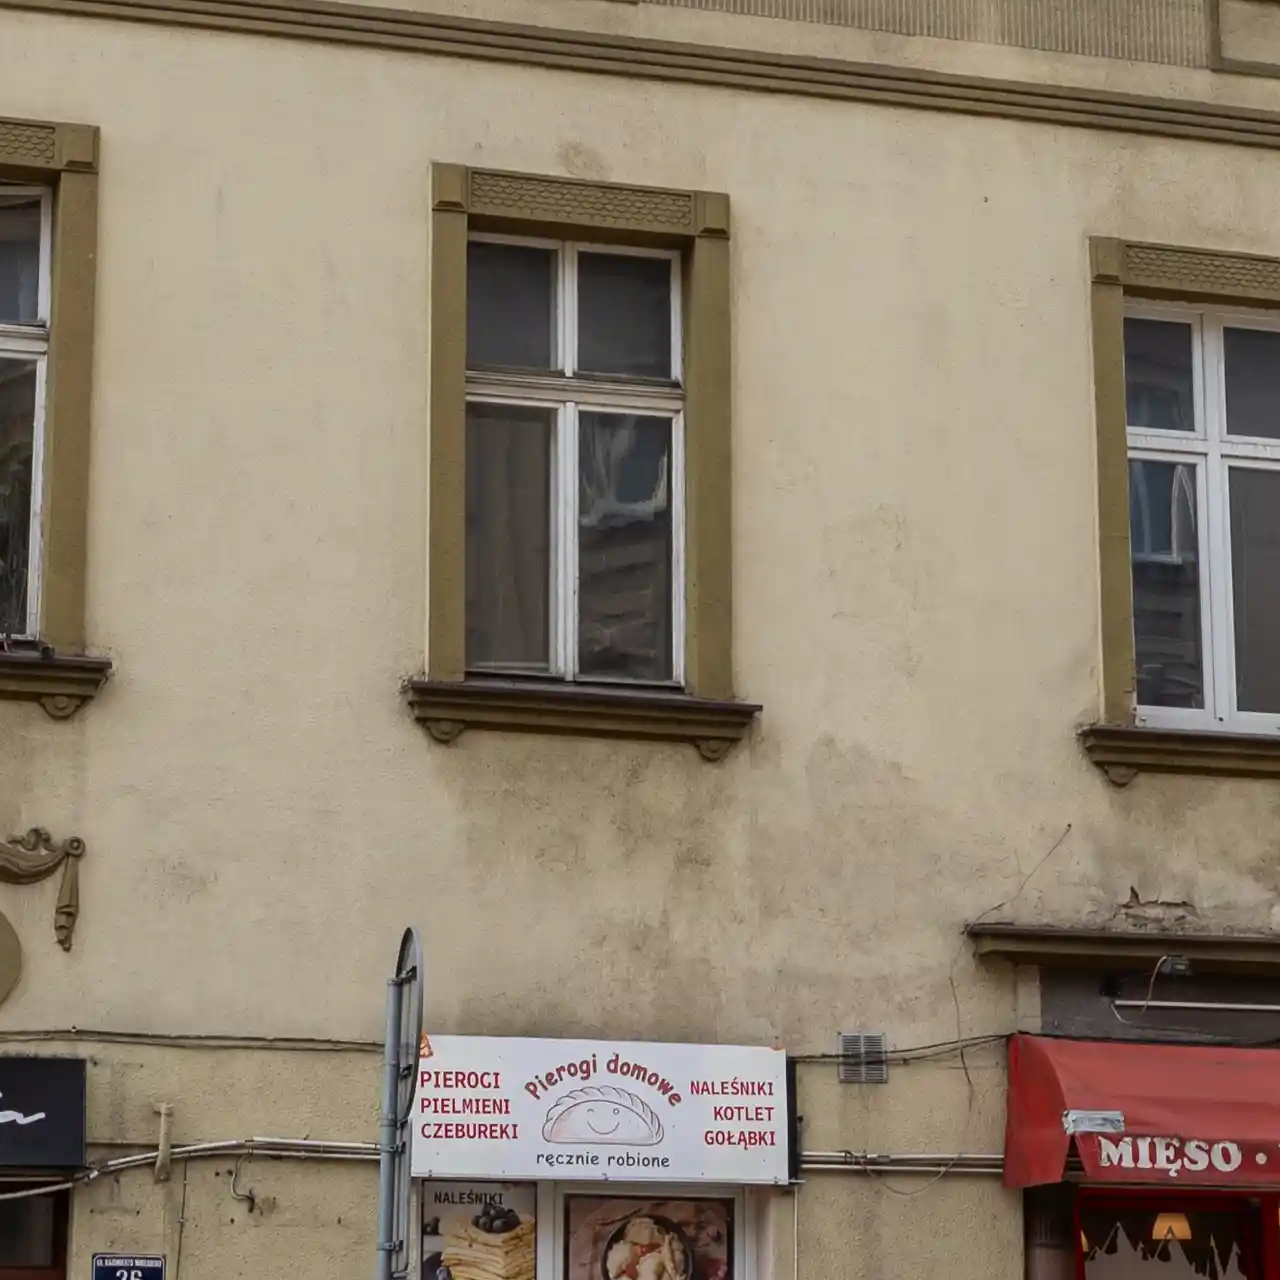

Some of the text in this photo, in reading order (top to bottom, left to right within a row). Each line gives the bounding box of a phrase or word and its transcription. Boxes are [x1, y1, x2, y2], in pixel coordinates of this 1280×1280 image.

[420, 1071, 500, 1089] PIEROGI
[524, 1054, 682, 1107] Pierogi domowe
[690, 1076, 774, 1096] NALEŚNIKI
[420, 1098, 510, 1115] PIELMIENI
[713, 1106, 774, 1122] KOTLET
[421, 1123, 519, 1140] CZEBUREKI
[704, 1131, 776, 1150] GOŁĄBKI
[536, 1151, 670, 1168] ręcznie robione
[1098, 1137, 1242, 1177] MIĘSO
[434, 1189, 503, 1206] NALEŚNIKI
